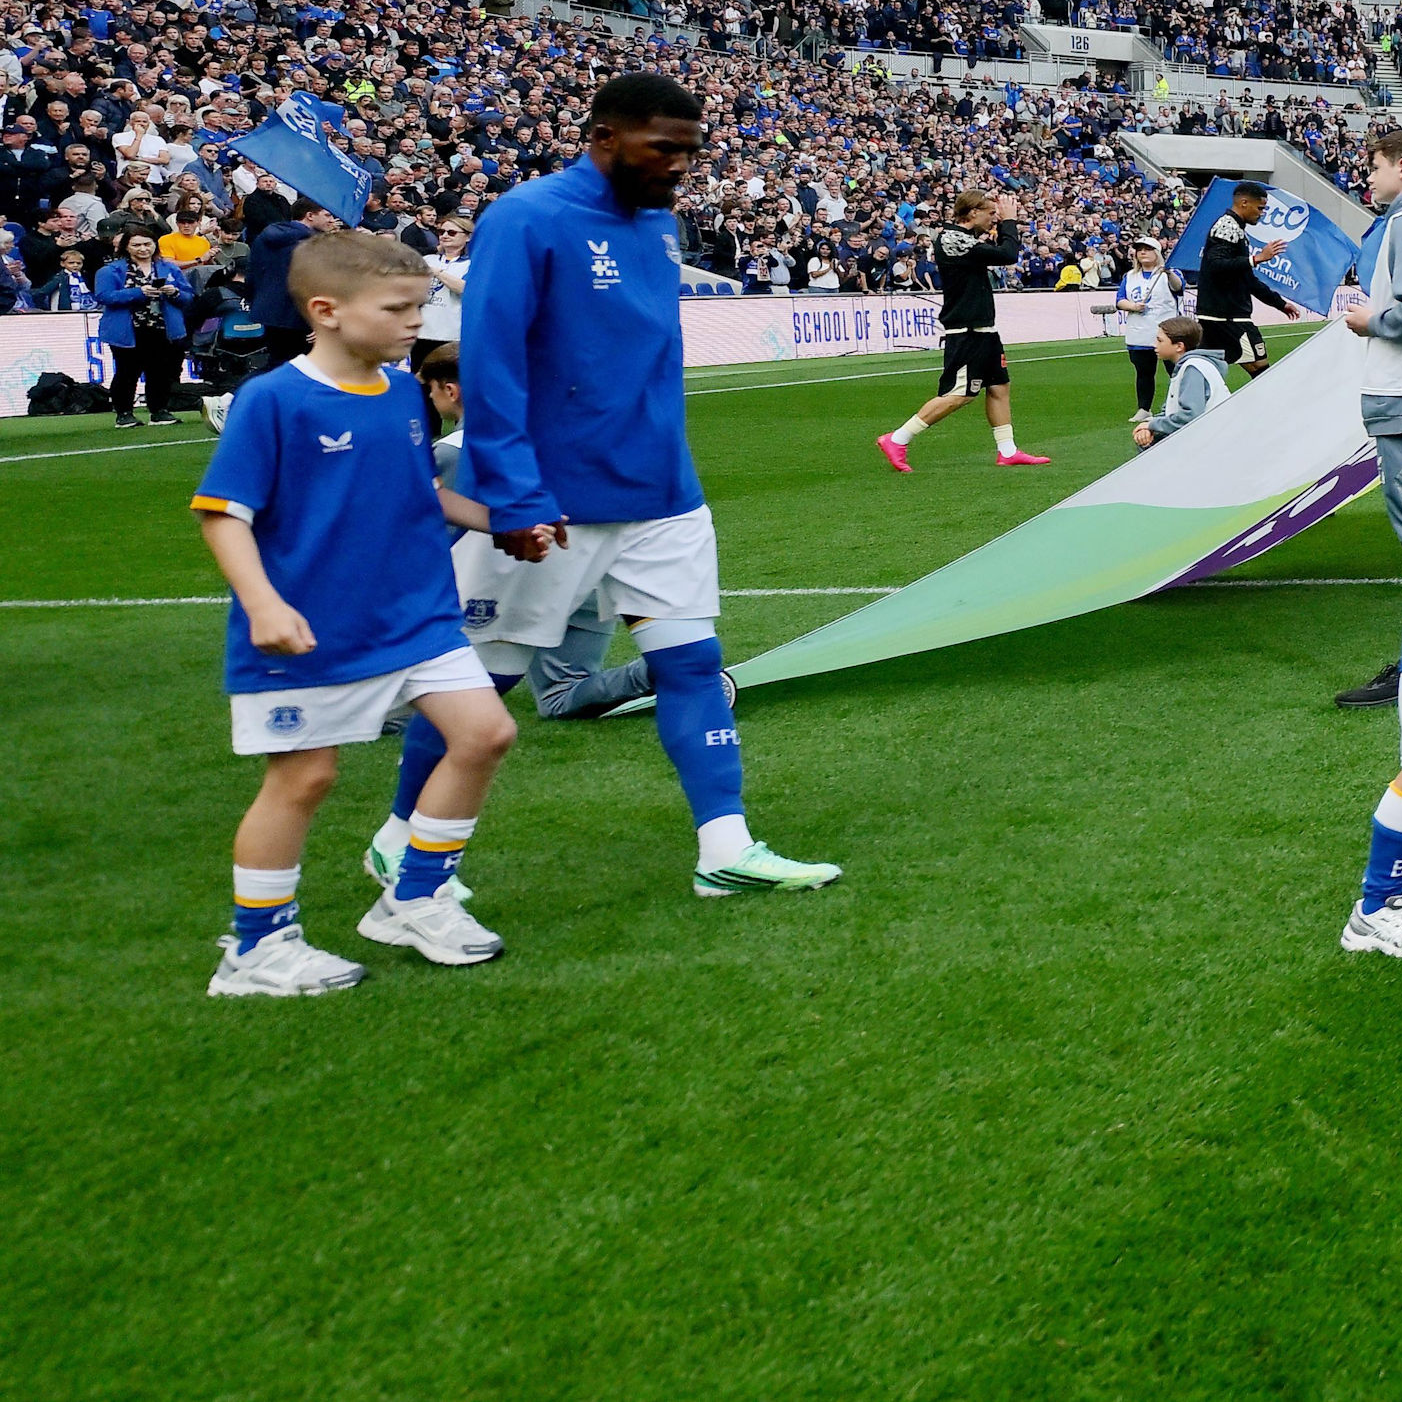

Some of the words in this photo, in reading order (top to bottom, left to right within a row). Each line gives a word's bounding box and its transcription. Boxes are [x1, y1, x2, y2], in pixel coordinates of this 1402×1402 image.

[1071, 35, 1090, 50] 126
[1259, 205, 1310, 231] itC
[793, 310, 850, 345] SCHOOL
[855, 310, 871, 341] OF
[882, 307, 936, 339] SCIENCE
